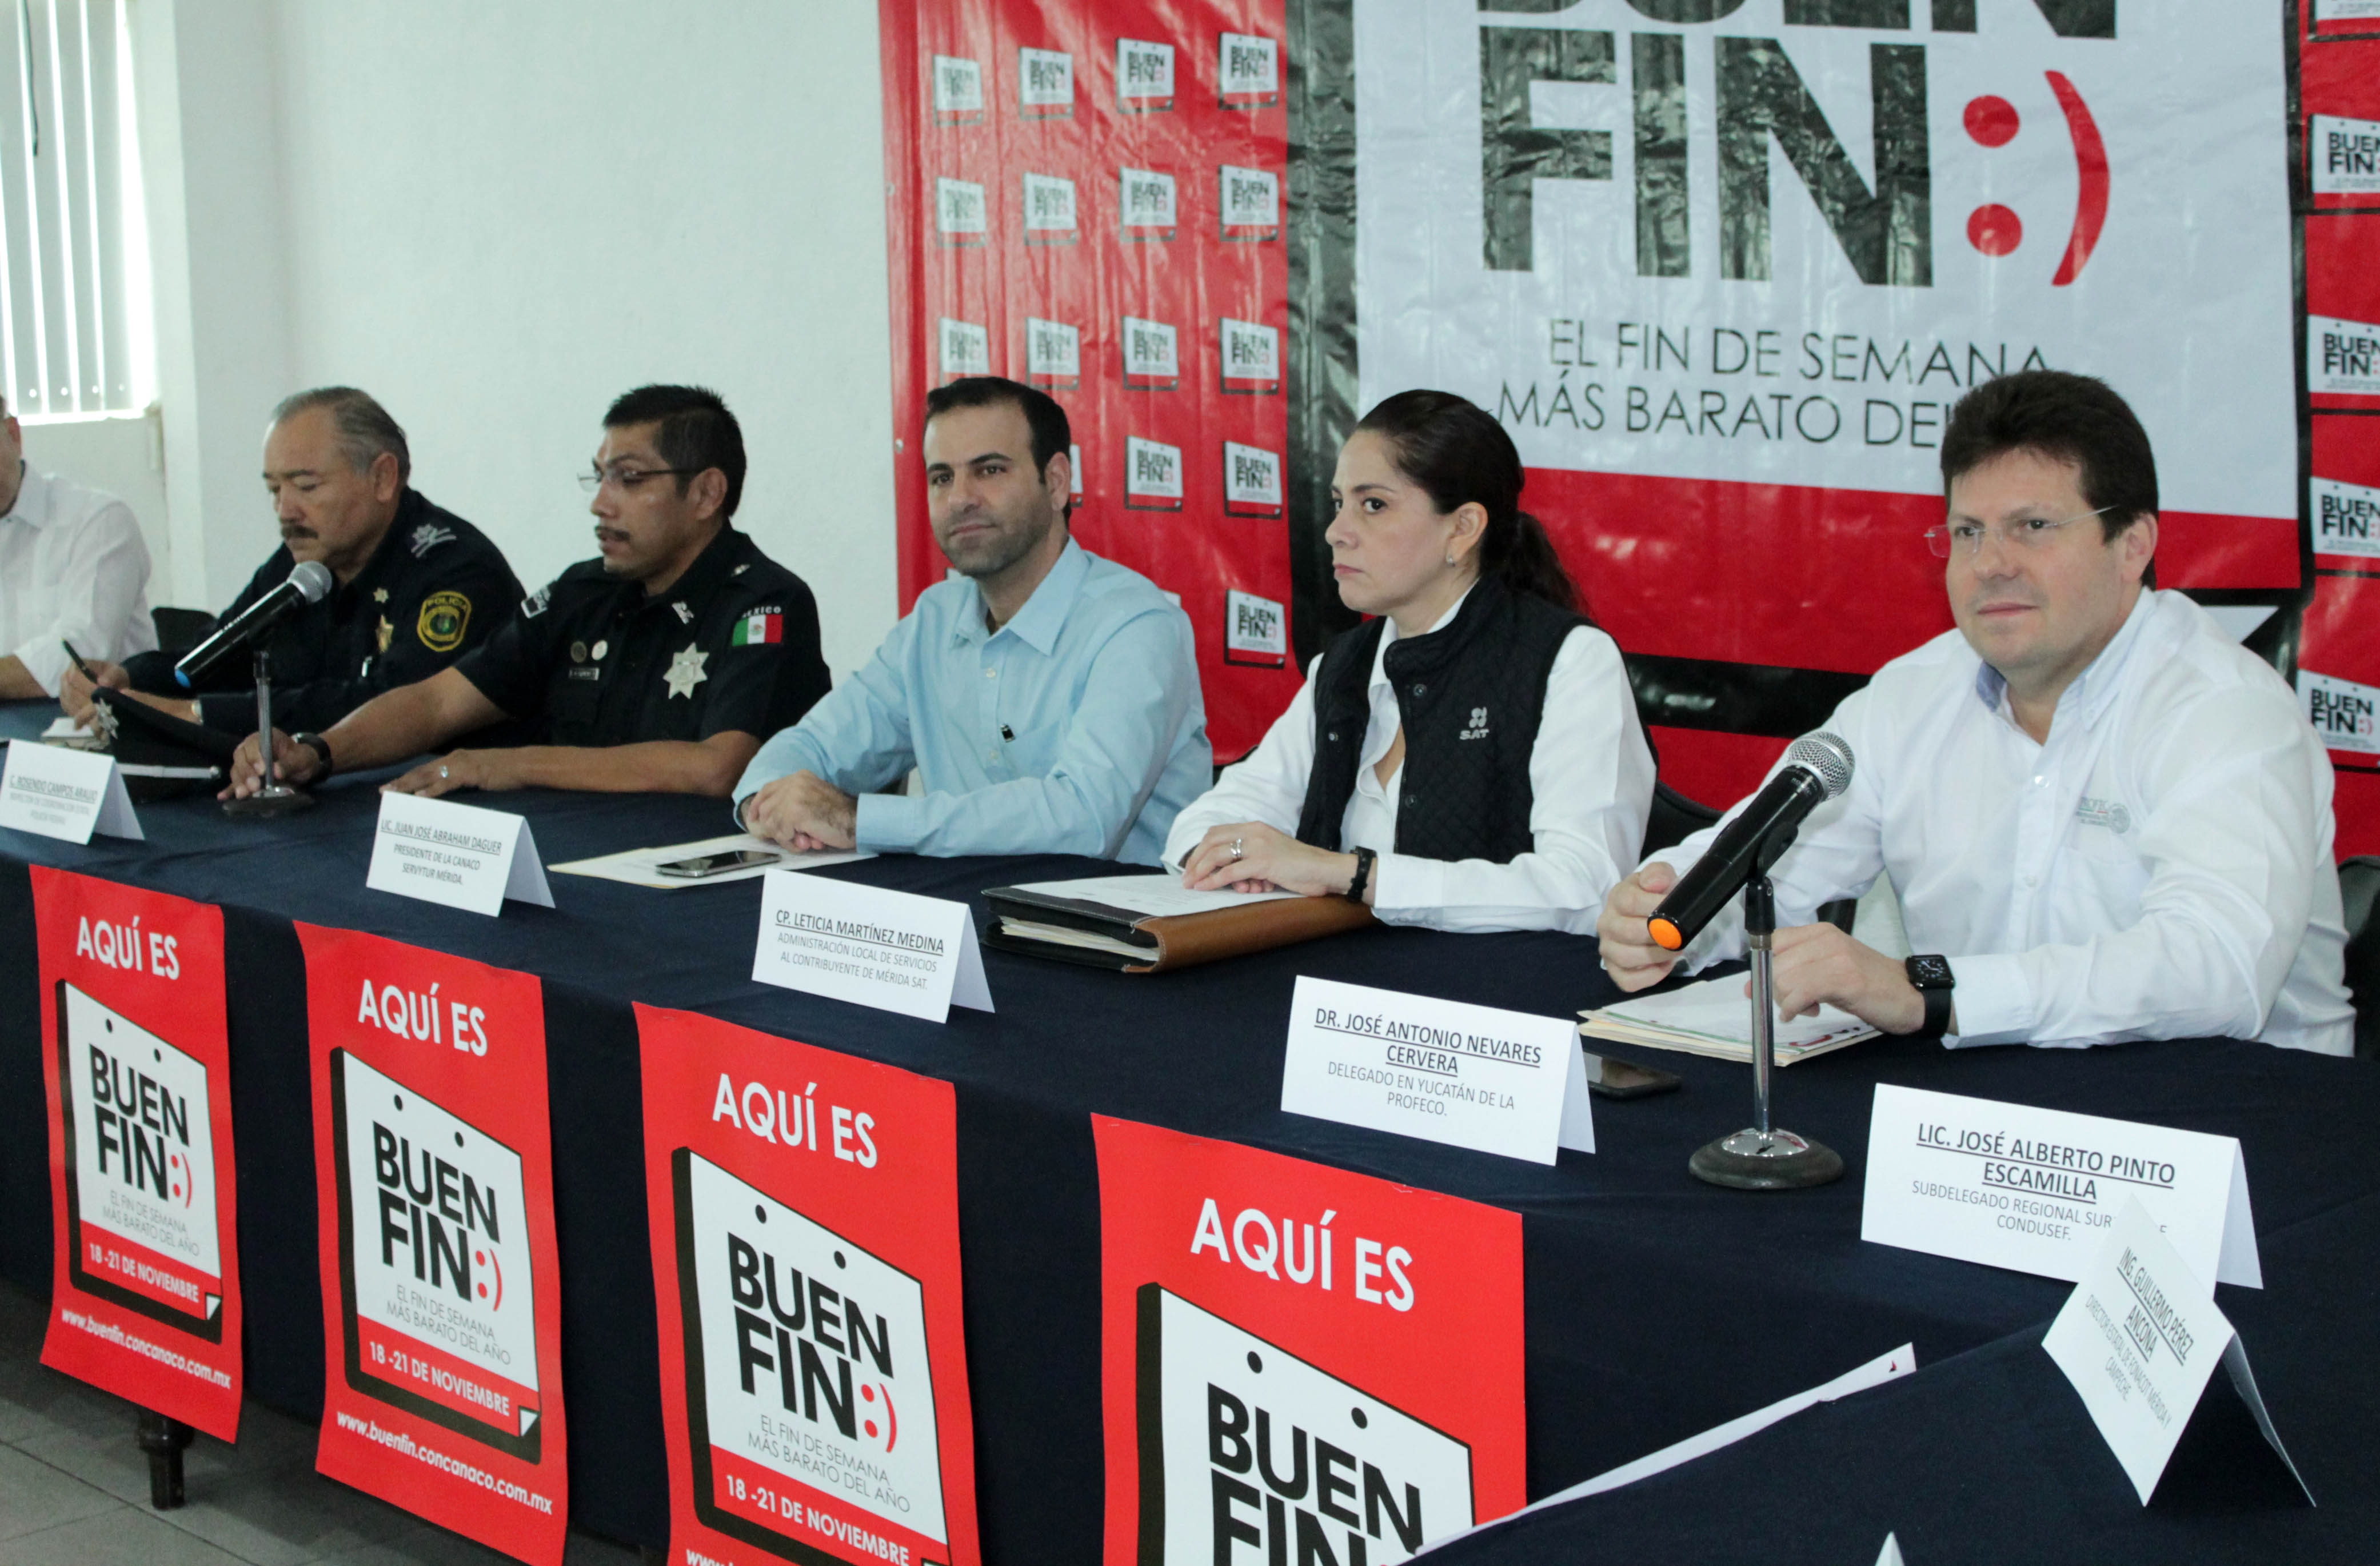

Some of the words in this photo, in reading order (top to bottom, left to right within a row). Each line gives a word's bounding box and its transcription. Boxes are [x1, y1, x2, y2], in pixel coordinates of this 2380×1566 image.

[2329, 131, 2380, 152] BUE
[1550, 318, 1598, 367] EL
[1618, 322, 1690, 371] FIN
[1713, 327, 1781, 377] DE
[1498, 369, 1605, 431] MÁS
[1627, 386, 1840, 444] BARATO
[2311, 688, 2374, 716] BUEN
[1459, 728, 1490, 741] SAT
[393, 844, 432, 861] PRESIDENTE
[433, 852, 442, 862] DE
[443, 854, 452, 864] LA
[452, 856, 481, 871] CANACO
[394, 821, 413, 836] JUAN
[414, 825, 432, 839] JOSÉ
[433, 828, 470, 846] ABRAHAM
[472, 836, 502, 853] DAGUER
[402, 862, 436, 879] SERVYTUR
[76, 915, 143, 972] AQUÍ
[149, 932, 180, 980] ES
[777, 932, 849, 956] ADMINISTRACIÓN
[852, 947, 878, 961] LOCAL
[880, 952, 891, 964] DE
[894, 954, 937, 973] SERVICIOS
[794, 913, 833, 933] LETICIA
[836, 920, 894, 944] MARTÍNEZ
[897, 932, 944, 953] MEDINA
[780, 950, 791, 962] AL
[793, 953, 860, 977] CONTRIBUYENTE
[862, 966, 873, 980] DE
[876, 968, 909, 986] MÉRIDA
[357, 978, 442, 1044] AQUÍ
[450, 1001, 488, 1057] ES
[1315, 1008, 1341, 1028] DR.
[1345, 1013, 1383, 1035] JOSÉ
[1385, 1020, 1462, 1049] ANTONIO
[1467, 1034, 1542, 1064] NEVARES
[1328, 1060, 1394, 1086] DELEGADO
[1397, 1073, 1414, 1090] EN
[1417, 1077, 1475, 1102] YUCATÁN
[1479, 1089, 1496, 1106] DE
[1500, 1092, 1515, 1110] LA
[1386, 1044, 1459, 1073] CERVERA
[89, 1043, 190, 1148] BUEN
[712, 1072, 817, 1152] AQUÍ
[830, 1105, 878, 1169] ES
[1387, 1092, 1447, 1117] PROFECO.
[1918, 1122, 1951, 1147] LIC.
[1955, 1128, 2005, 1156] JOSÉ
[2009, 1138, 2104, 1170] ALBERTO
[2110, 1154, 2175, 1184] PINTO
[1983, 1161, 2098, 1200] ESCAMILLA
[110, 1189, 120, 1207] EL
[121, 1194, 134, 1212] FIN
[137, 1201, 149, 1220] DE
[150, 1207, 187, 1232] SEMANA
[372, 1120, 501, 1245] BUEN
[1911, 1180, 2010, 1211] SUBDELEGADO
[2012, 1199, 2082, 1224] REGIONAL
[123, 1212, 158, 1239] BARATO
[159, 1228, 175, 1248] DEL
[1189, 1197, 1337, 1291] AQUÍ
[1355, 1236, 1415, 1312] ES
[1996, 1214, 2072, 1241] CONDUSEF.
[89, 1243, 102, 1264] 18
[121, 1256, 135, 1278] DE
[137, 1261, 199, 1304] NOVIEMBRE
[397, 1284, 408, 1304] EL
[411, 1291, 427, 1311] FIN
[430, 1299, 445, 1320] DE
[447, 1307, 496, 1341] SEMANA
[728, 1231, 895, 1380] BUEN
[2126, 1304, 2158, 1359] ANCONA
[2134, 1266, 2175, 1331] GUILLERMO
[2170, 1317, 2195, 1361] PÉREZ
[61, 1308, 231, 1389] www.buenfin.concanaco.com.mx
[413, 1311, 457, 1343] BARATO
[460, 1331, 481, 1353] DEL
[483, 1343, 511, 1365] AÑO
[2085, 1293, 2111, 1335] DIRECTOR
[2127, 1356, 2152, 1396] FONACOT
[369, 1341, 386, 1365] 18
[412, 1358, 429, 1383] DE
[431, 1367, 510, 1417] NOVIEMBRE
[336, 1410, 553, 1516] www.buenfin.concanaco.com.mx
[748, 1427, 780, 1459] MÁS
[783, 1448, 840, 1484] BARATO
[844, 1471, 871, 1498] DEL
[874, 1487, 911, 1513] AÑO
[760, 1414, 776, 1436] EL
[779, 1423, 800, 1446] FIN
[804, 1432, 824, 1453] DE
[826, 1440, 891, 1486] SEMANA
[1207, 1381, 1424, 1556] BUEN
[726, 1475, 747, 1501] 18
[781, 1495, 803, 1524] DE
[806, 1506, 909, 1566] NOVIEMBRE
